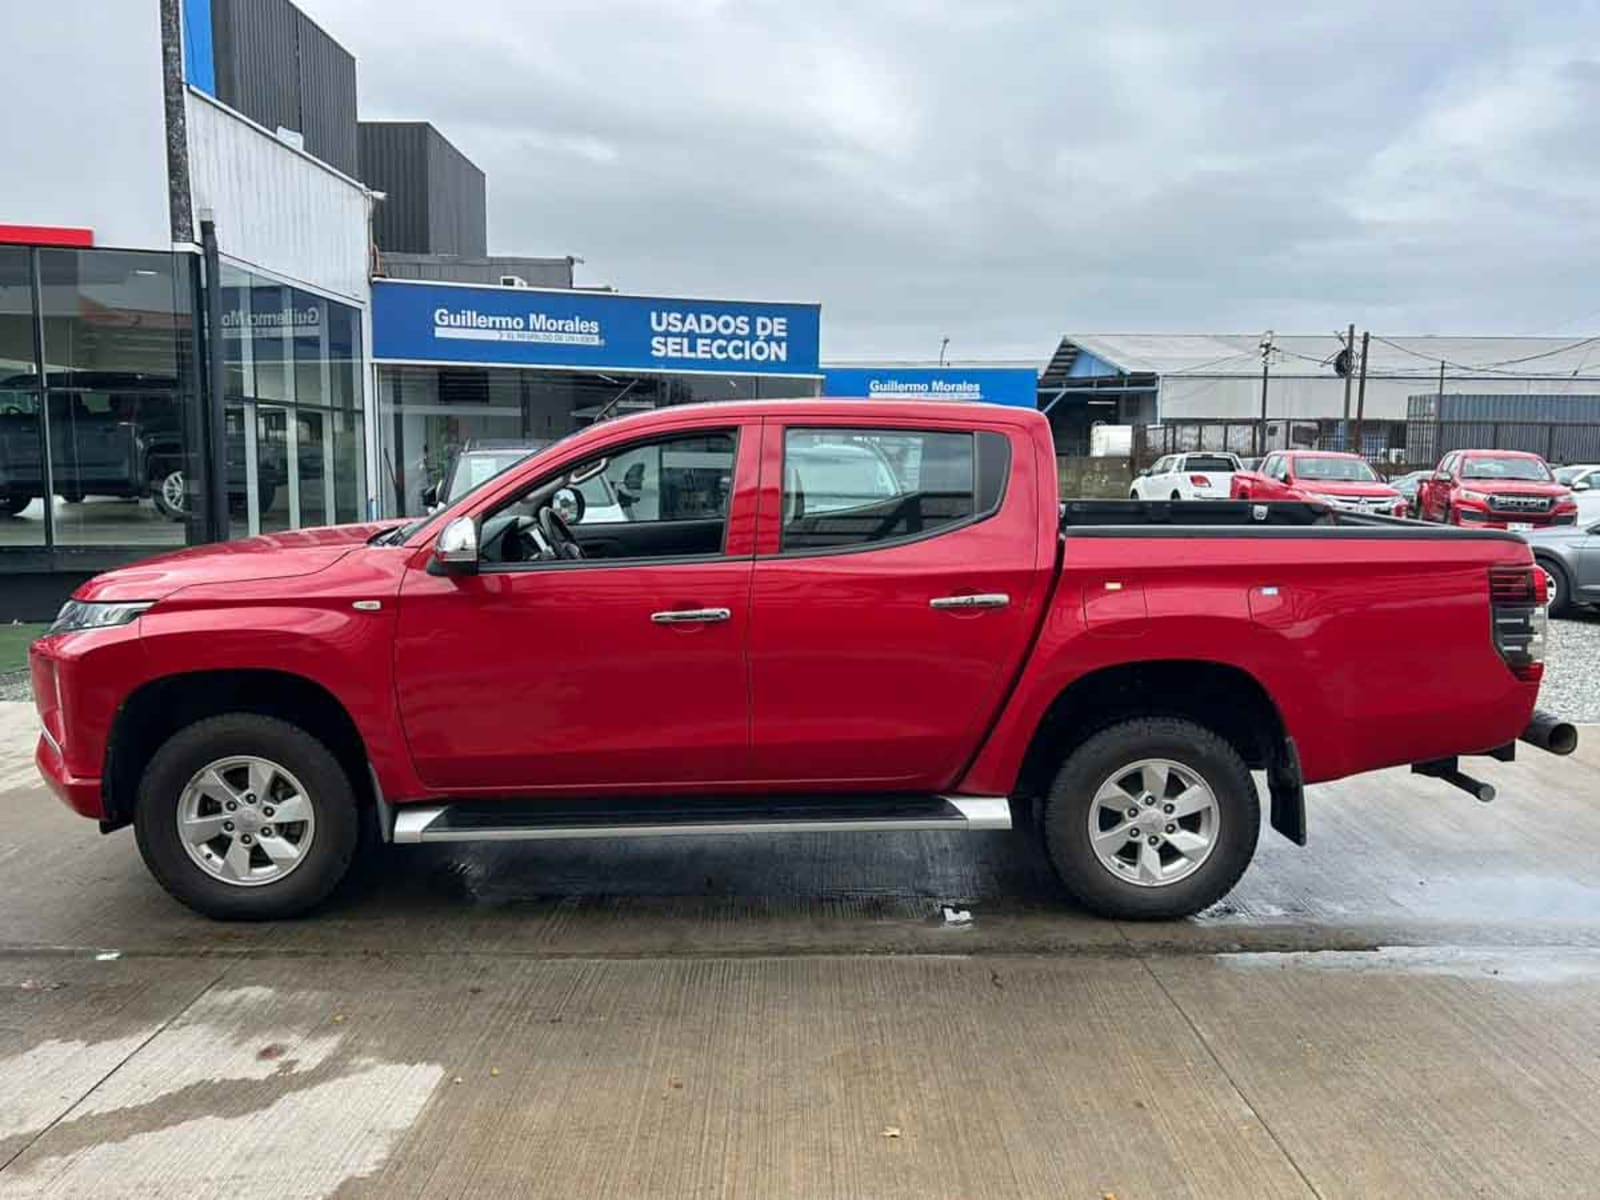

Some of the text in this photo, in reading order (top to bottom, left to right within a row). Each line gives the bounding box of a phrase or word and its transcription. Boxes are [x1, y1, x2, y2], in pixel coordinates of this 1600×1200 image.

[434, 308, 599, 333] Guillermo Morales
[650, 311, 788, 337] USADOS DE
[650, 335, 787, 361] SELECCIÓN
[869, 379, 980, 392] Guillermo Morales
